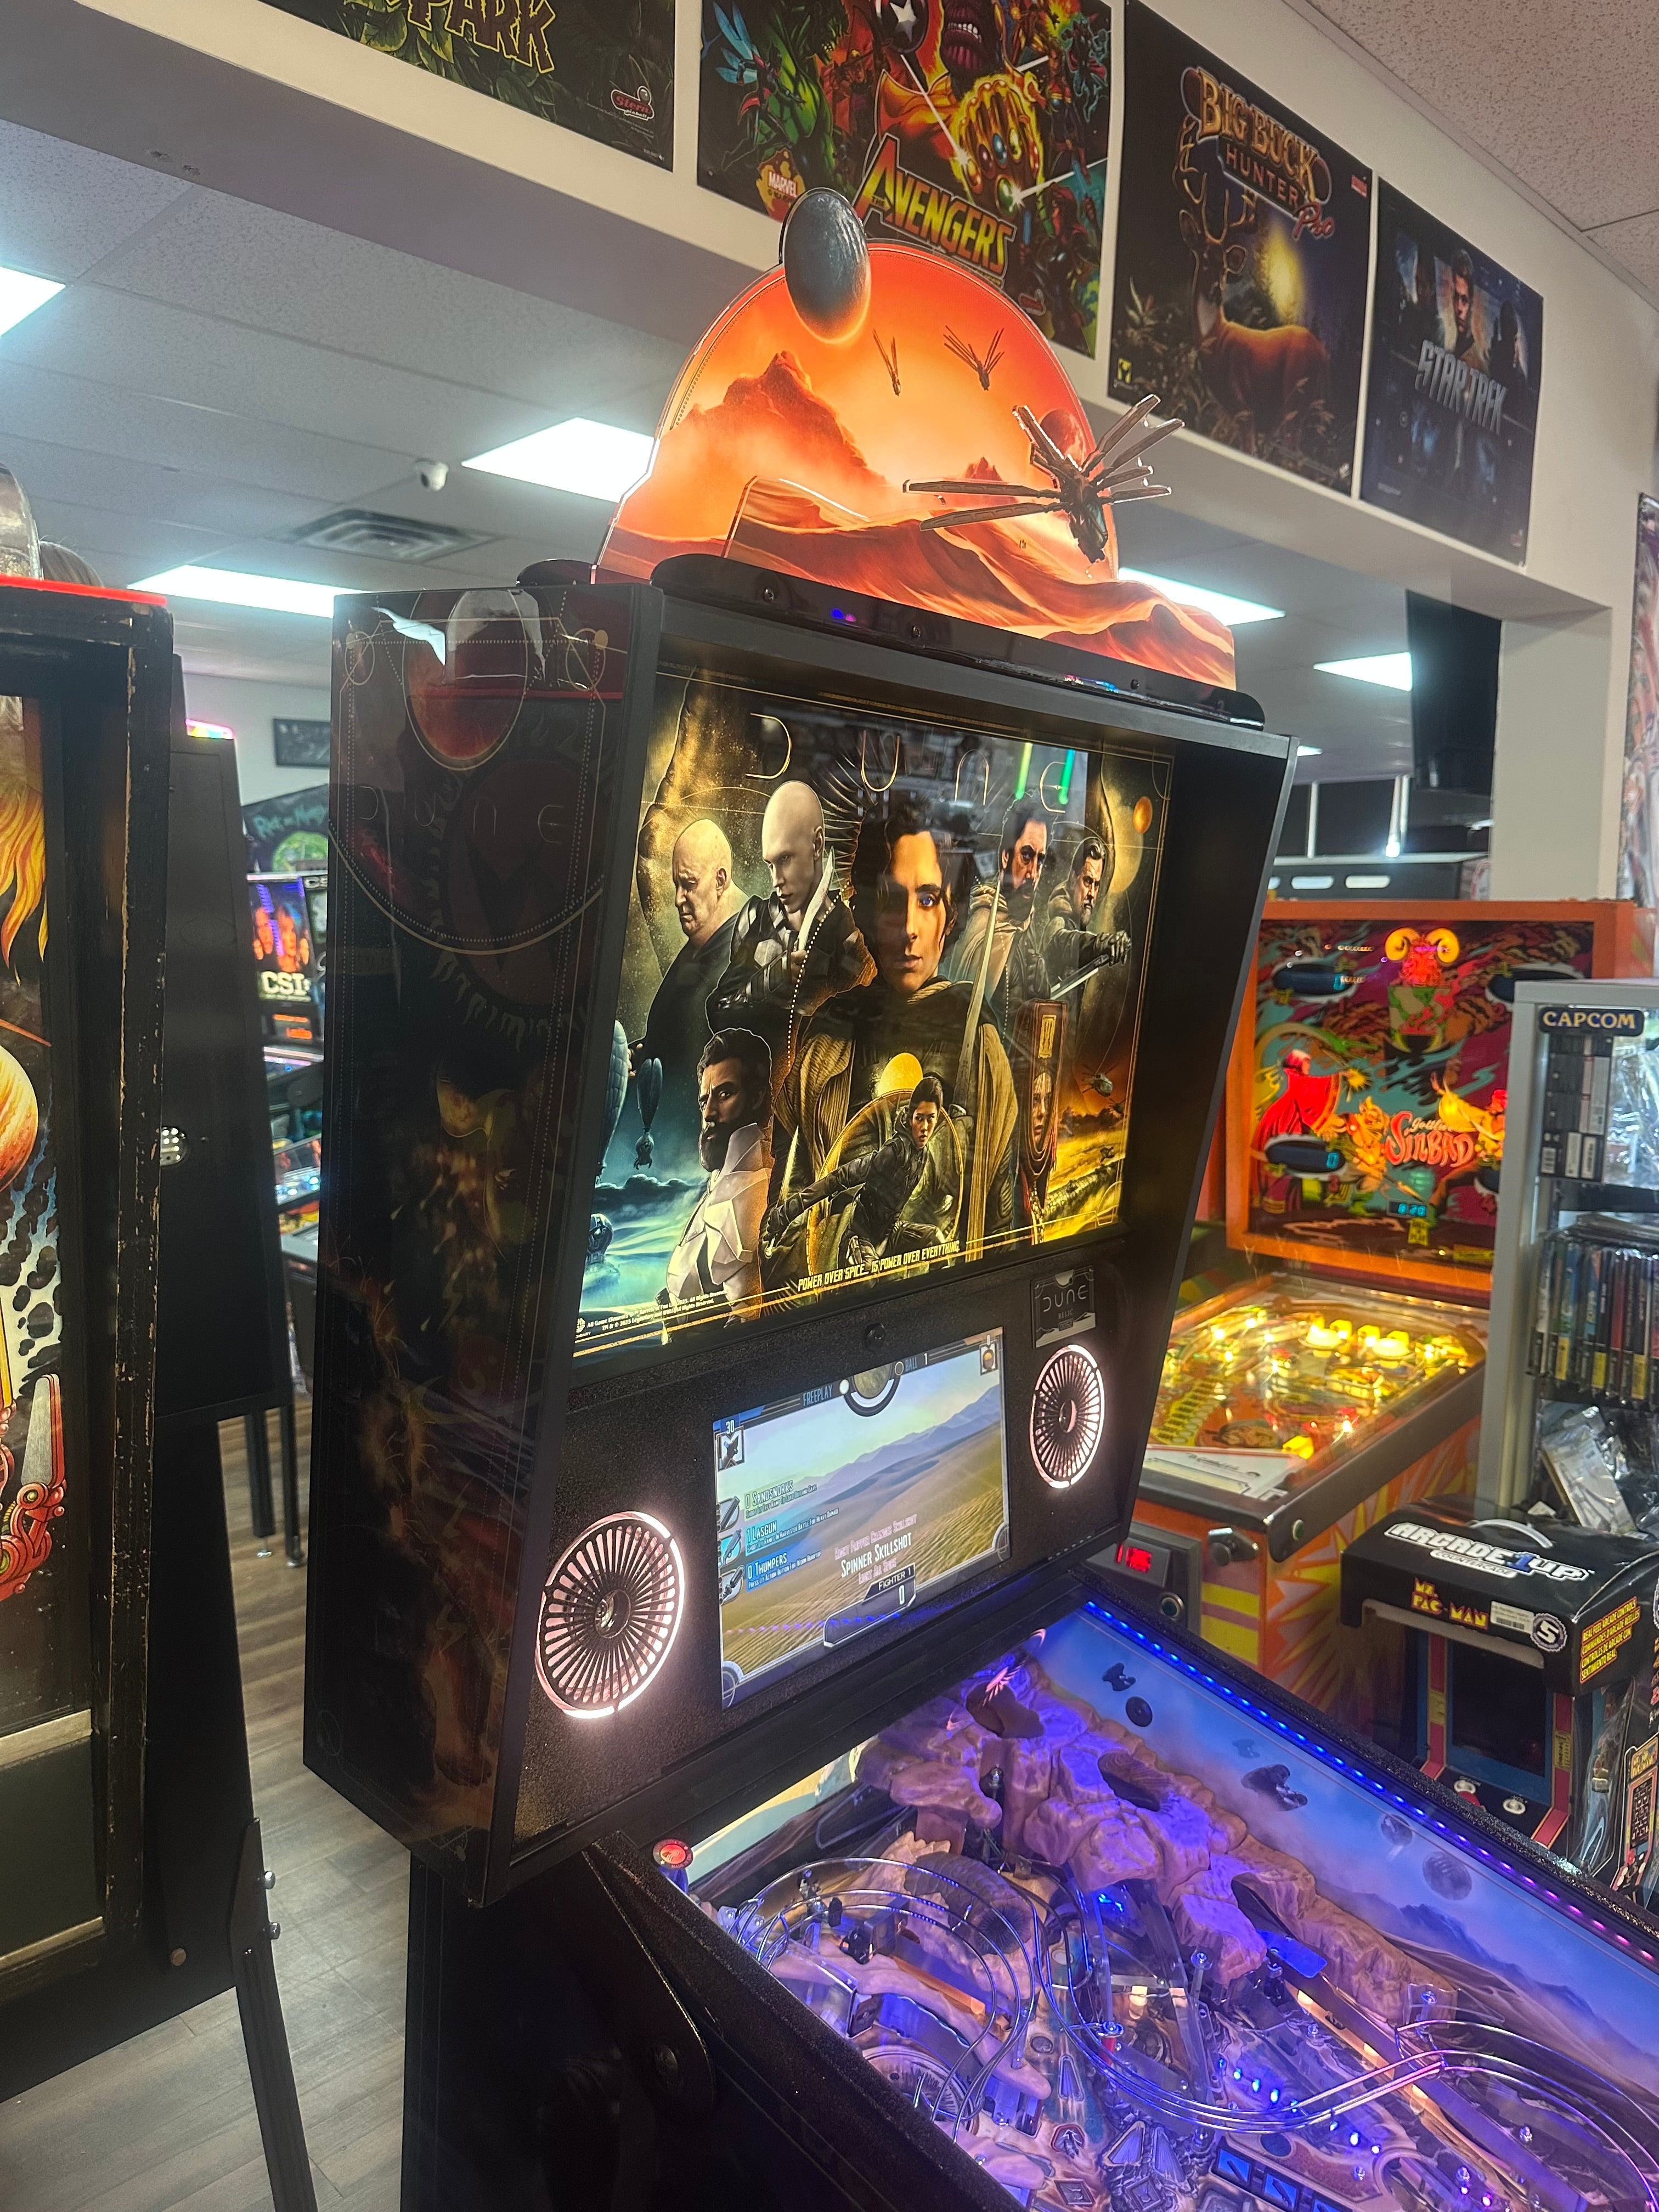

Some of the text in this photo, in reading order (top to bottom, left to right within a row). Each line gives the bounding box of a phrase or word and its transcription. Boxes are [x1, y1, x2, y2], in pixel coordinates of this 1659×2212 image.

[616, 95, 650, 114] Stern
[1198, 66, 1321, 204] BIG BUCK
[768, 171, 797, 199] MARVEL
[1226, 143, 1299, 211] HUNTER
[854, 134, 1015, 273] AVENGERS
[1415, 339, 1507, 435] STAR TREK
[1543, 1010, 1636, 1029] CAPCOM
[798, 1274, 823, 1292] POWER
[823, 1269, 843, 1284] OVER
[871, 1259, 879, 1273] IS
[879, 1254, 902, 1271] POWER
[903, 1250, 921, 1265] OVER
[1043, 1284, 1088, 1312] DUNE
[905, 1352, 928, 1372] BALL 1
[803, 1384, 833, 1407] FREEPLAY
[725, 1419, 735, 1434] 30
[1435, 1551, 1513, 1576] COUNTERCADE
[878, 1567, 911, 1591] FIGHTER 1
[899, 1584, 905, 1605] 0
[1617, 1599, 1637, 1619] CONTROLS
